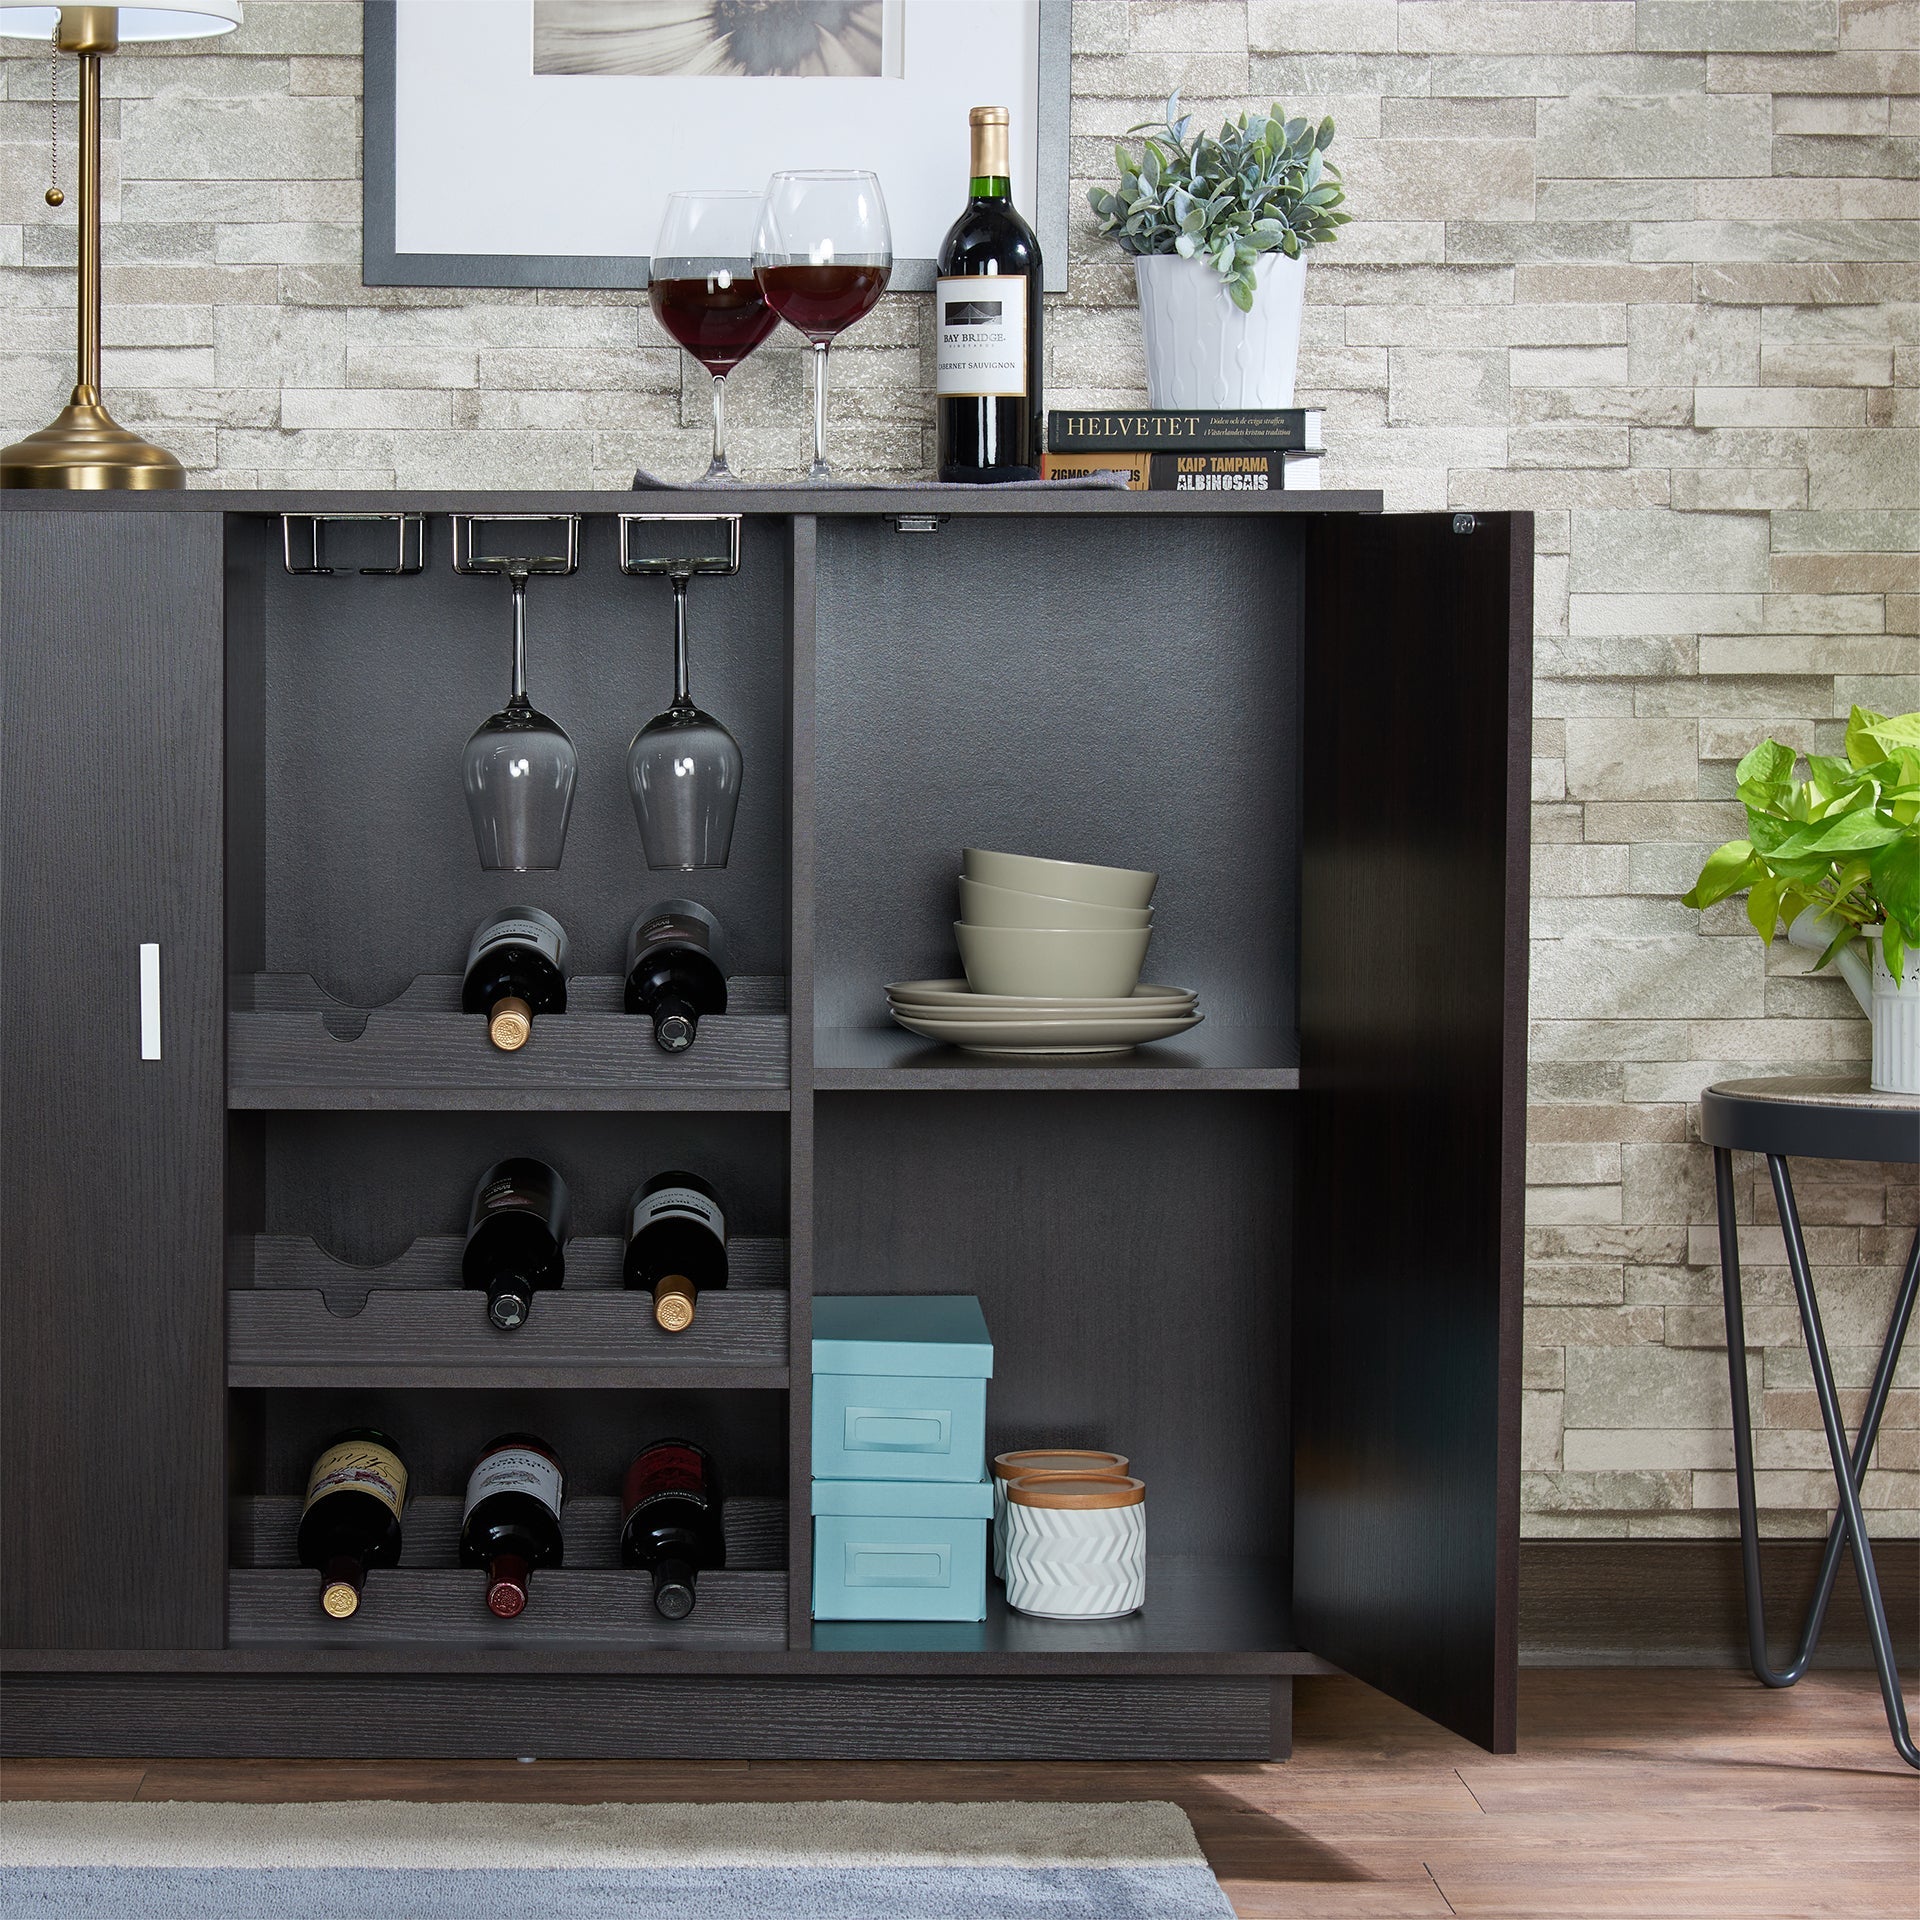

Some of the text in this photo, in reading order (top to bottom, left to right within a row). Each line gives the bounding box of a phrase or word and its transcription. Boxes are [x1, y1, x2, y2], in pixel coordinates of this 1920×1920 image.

[944, 334, 959, 343] BAY
[968, 361, 1016, 369] SAUVIGNON
[1067, 417, 1200, 436] HELVETET
[1239, 417, 1247, 425] de
[1177, 457, 1269, 472] KAIP TAMPAMA
[1176, 475, 1269, 491] ALBINOSAIS
